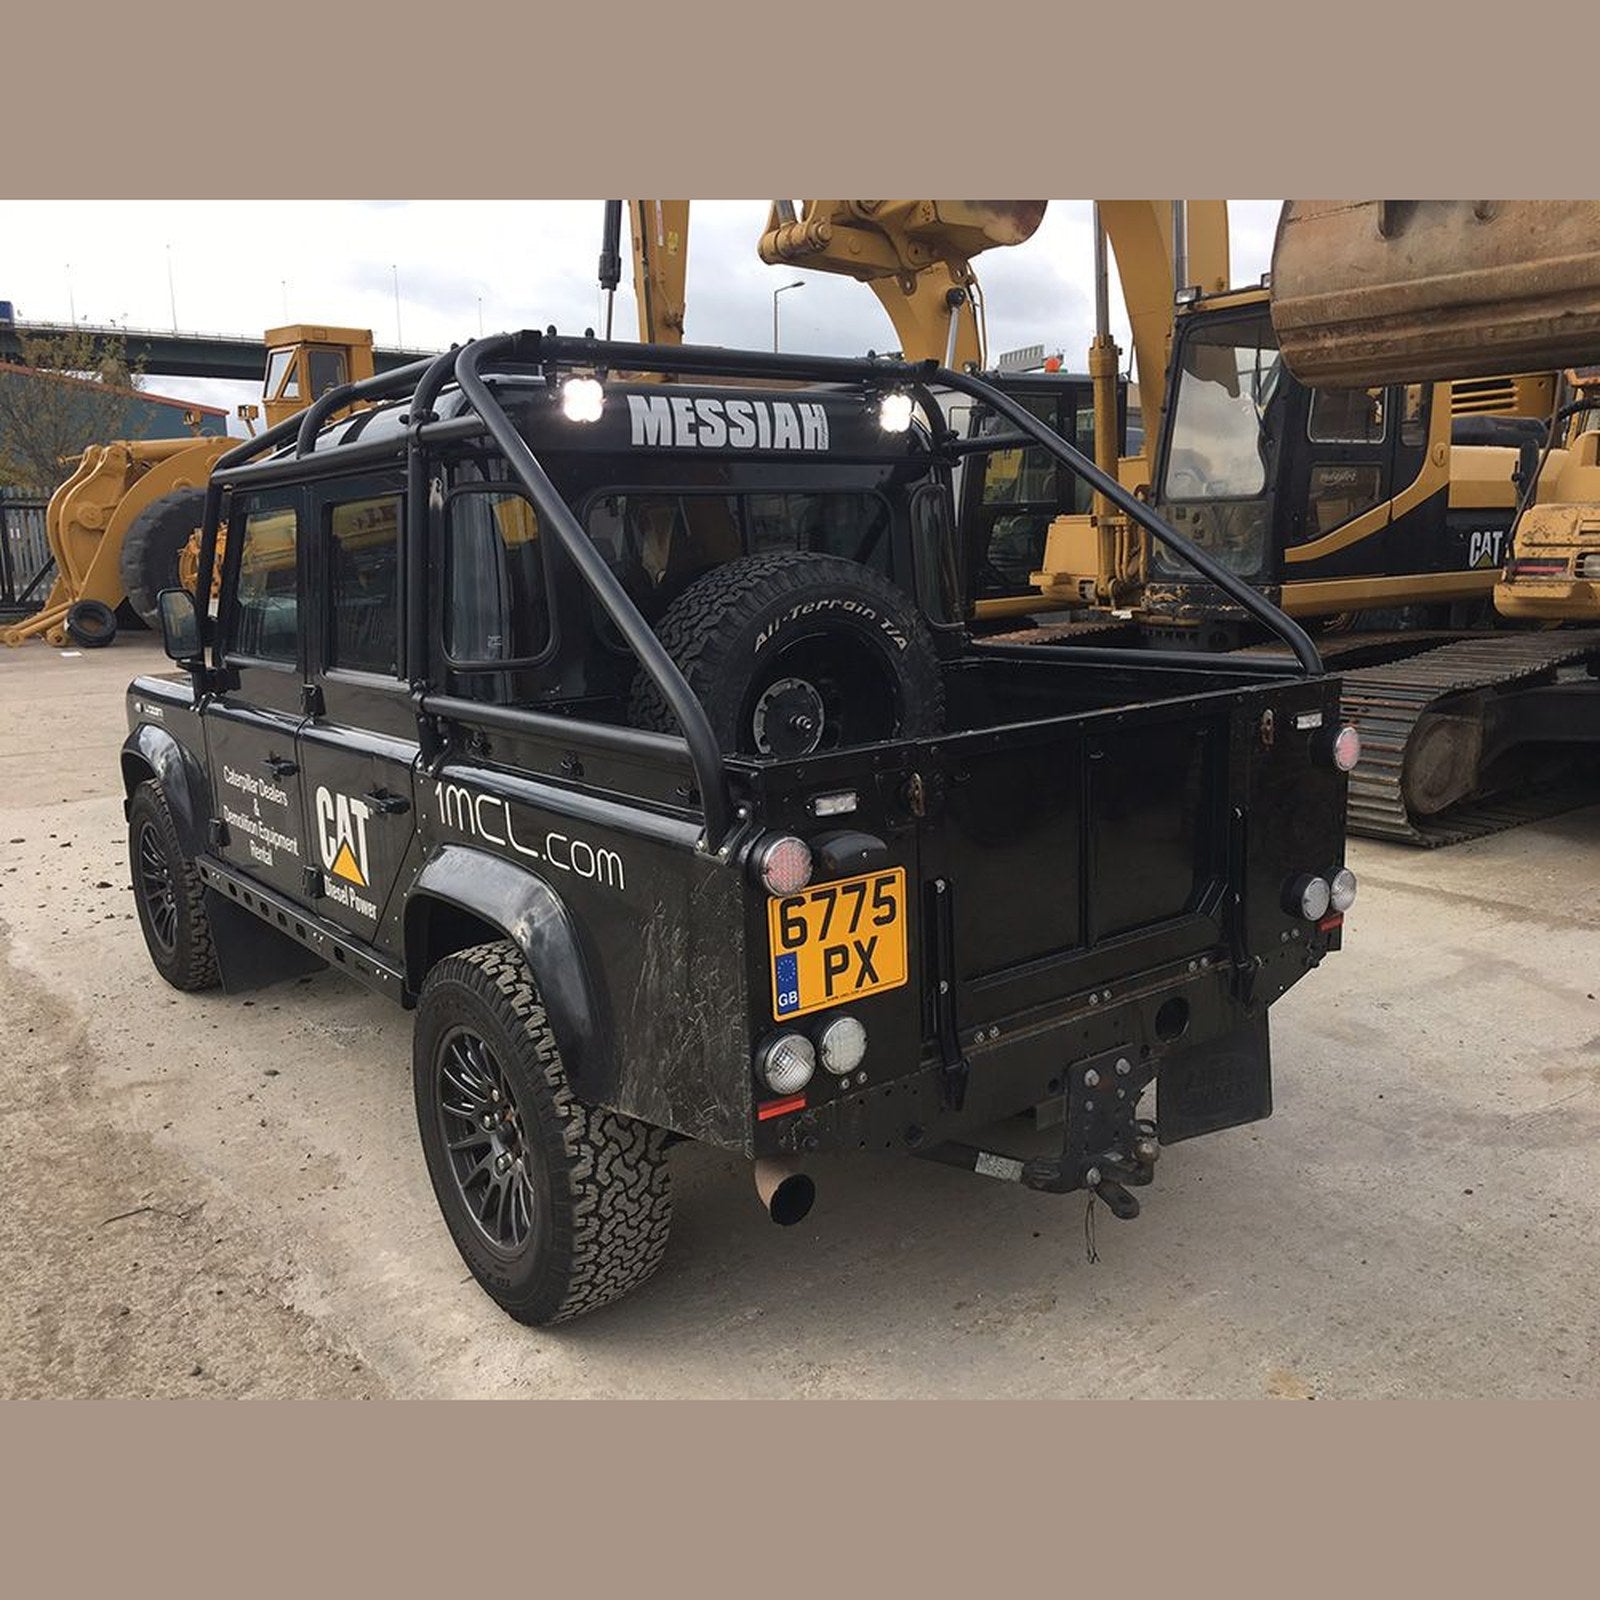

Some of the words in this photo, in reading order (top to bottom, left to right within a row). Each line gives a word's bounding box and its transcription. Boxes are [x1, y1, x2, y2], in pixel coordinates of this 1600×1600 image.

[627, 395, 829, 450] MESSIAH
[1469, 531, 1504, 567] CAT
[754, 599, 877, 652] All-Terrain
[880, 617, 908, 650] T/A
[223, 765, 259, 796] Caterpillar
[259, 778, 288, 807] Dealers
[253, 798, 261, 818] &
[223, 804, 260, 838] Demolition
[259, 820, 299, 857] Equipment
[249, 839, 273, 867] Rental
[316, 786, 370, 888] CAT
[324, 874, 350, 906] Diesel
[348, 886, 378, 921] Power
[779, 875, 897, 950] 6775
[824, 935, 880, 998] PX
[778, 991, 799, 1007] GB
